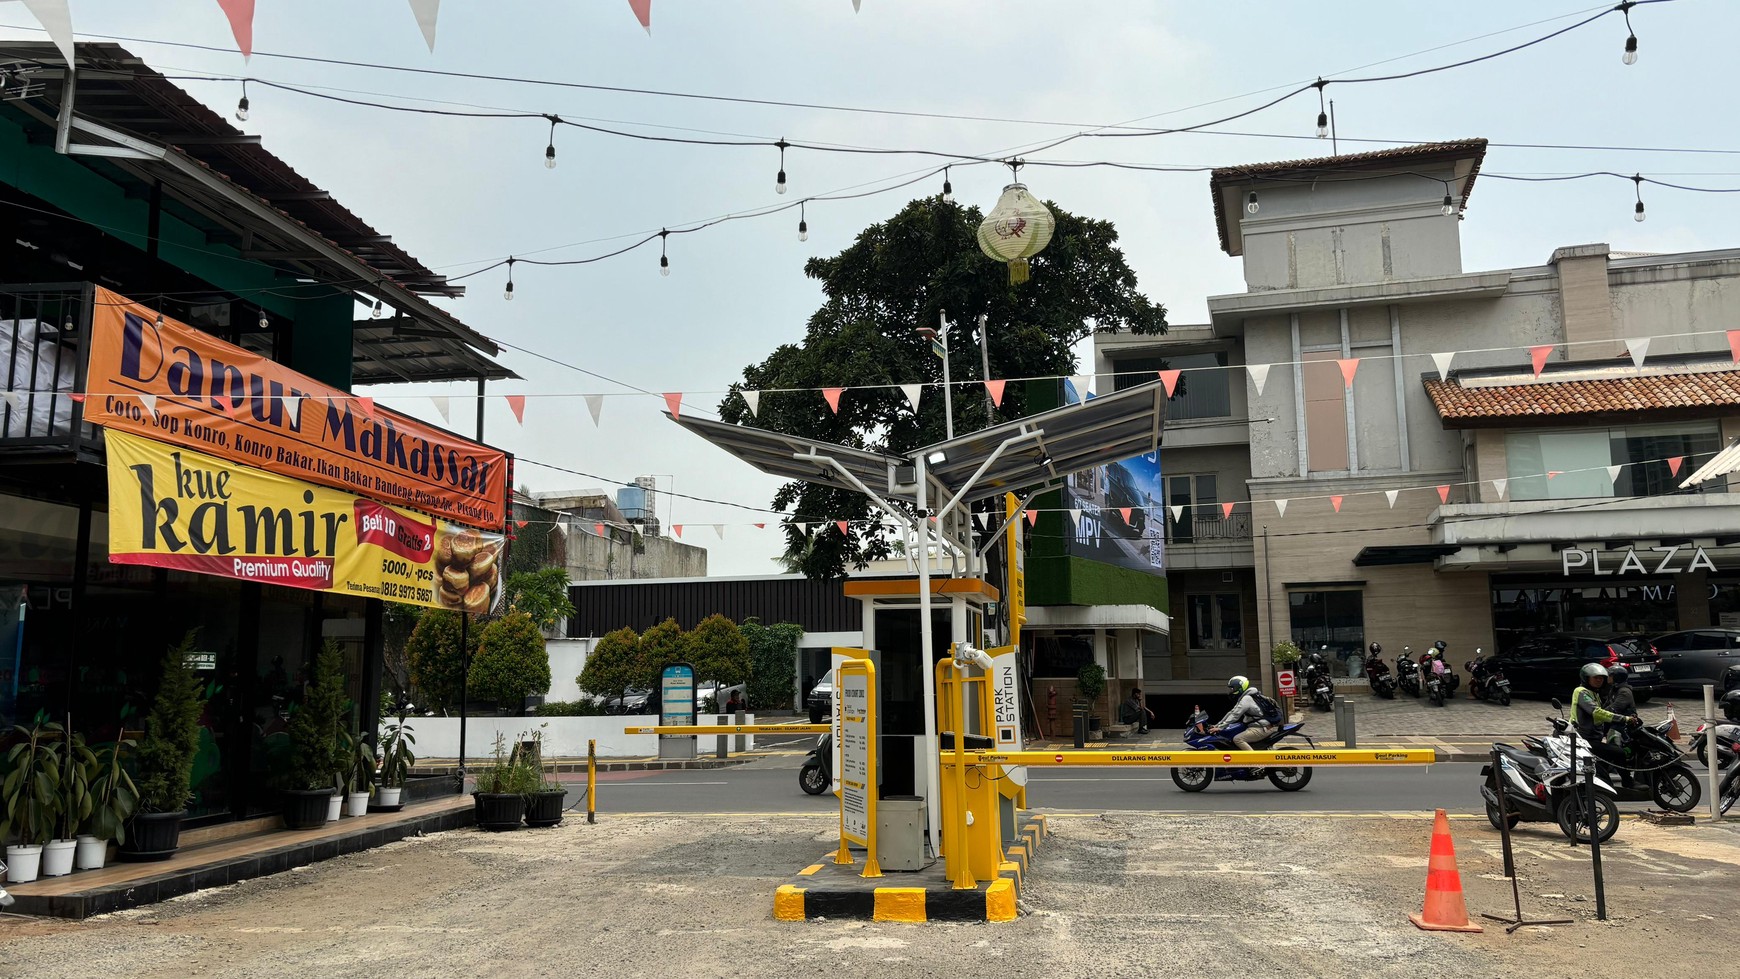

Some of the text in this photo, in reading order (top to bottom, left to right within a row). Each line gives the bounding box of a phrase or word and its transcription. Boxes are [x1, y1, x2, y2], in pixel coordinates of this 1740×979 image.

[120, 311, 493, 495] Dapur Makassar
[105, 395, 146, 426] Coto,
[153, 409, 179, 434] Sop
[183, 419, 230, 449] Konro,
[235, 433, 272, 460] Konro
[344, 466, 372, 489] Bakar
[457, 502, 482, 520] Pisang
[170, 452, 232, 499] kue
[130, 463, 348, 557] kamir
[362, 514, 431, 552] Beli 10 Gratis 2
[1075, 515, 1101, 548] MPV
[233, 558, 331, 581] Premium Quality
[1561, 545, 1718, 576] PLAZA
[381, 581, 397, 597] 0812
[398, 585, 415, 601] 9973
[416, 588, 433, 602] 5857
[996, 687, 1004, 723] PARK
[1003, 666, 1015, 722] STATION
